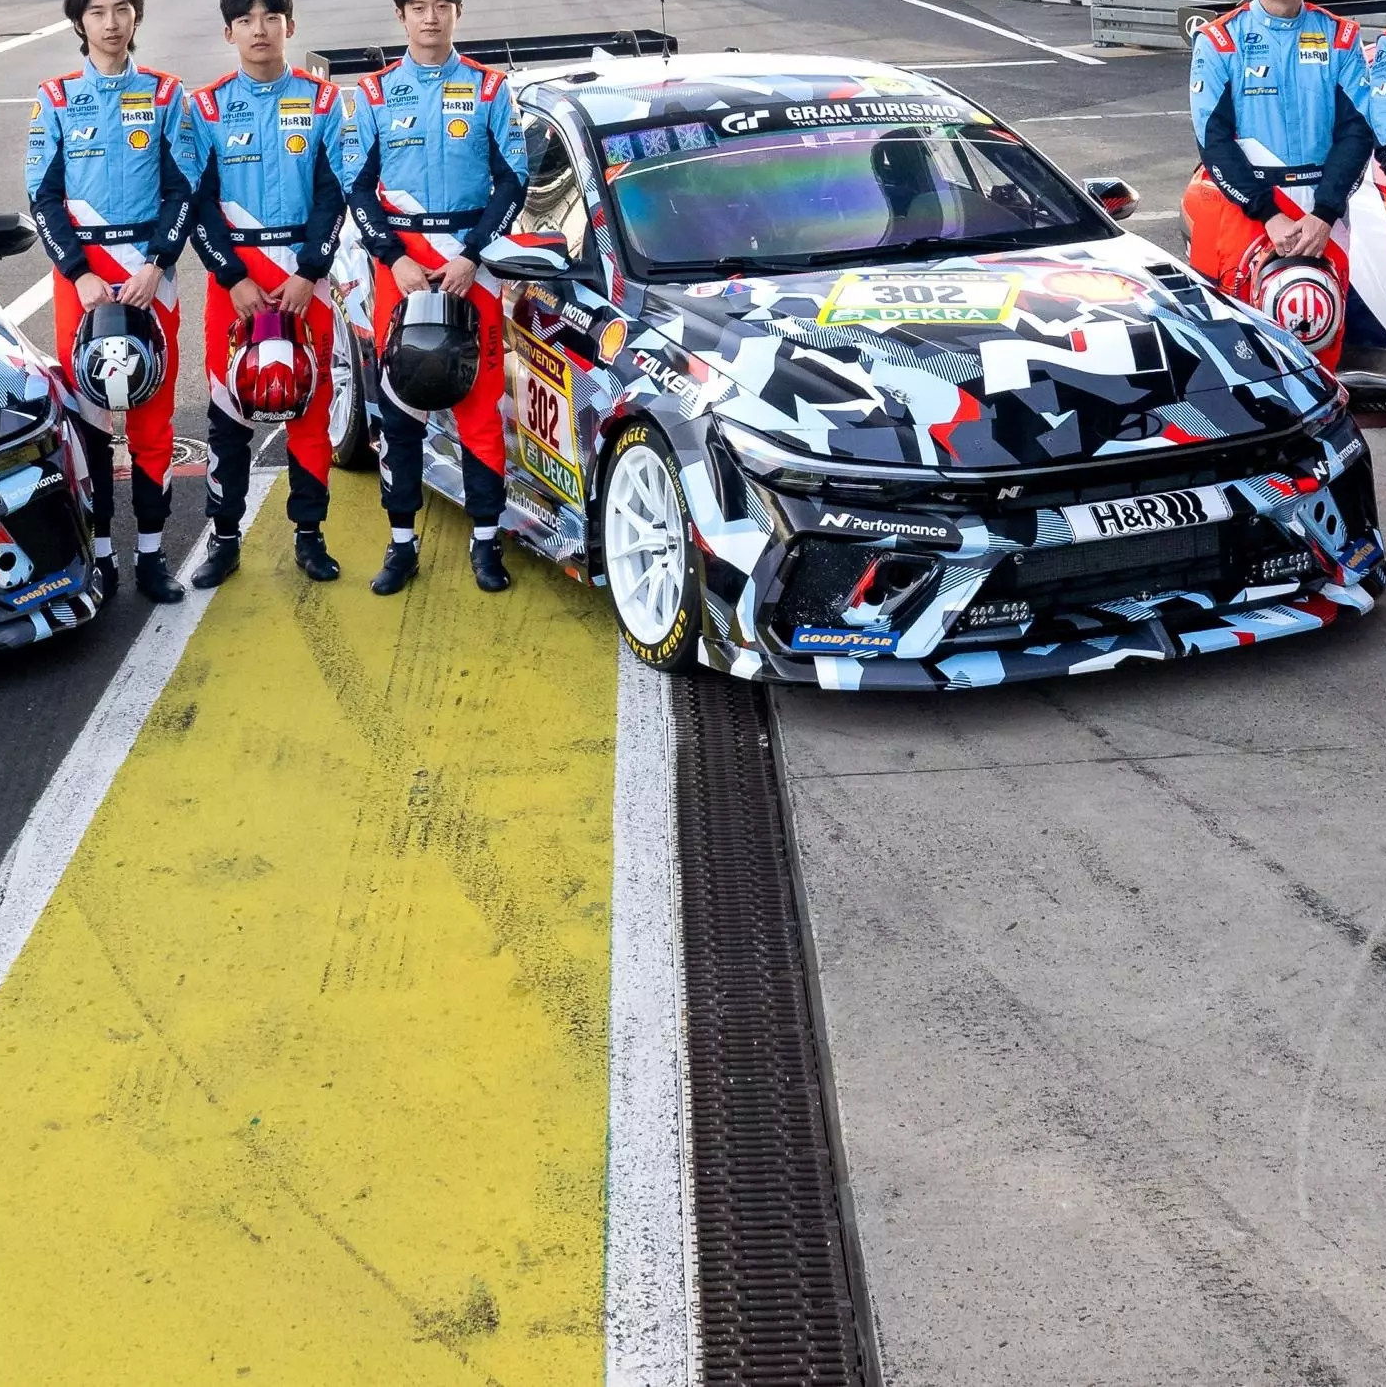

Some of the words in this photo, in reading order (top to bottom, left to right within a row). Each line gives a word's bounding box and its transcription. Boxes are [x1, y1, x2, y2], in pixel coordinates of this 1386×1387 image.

[1299, 50, 1320, 60] H&R
[441, 101, 462, 111] H&R
[785, 104, 852, 121] GRAN
[855, 102, 960, 119] TURISMO
[121, 113, 142, 122] H&R
[280, 117, 300, 126] H&R
[852, 116, 898, 124] DRIVING
[900, 115, 965, 124] SIMULATOR
[871, 284, 968, 305] 302
[562, 301, 594, 330] MOTON
[878, 307, 990, 322] DEKRA
[527, 376, 561, 450] 302
[616, 426, 650, 456] EAGLE
[541, 450, 581, 505] DEKRA
[852, 517, 948, 539] Performance
[1093, 498, 1167, 538] H&R
[13, 576, 73, 606] GOODYEAR
[797, 631, 894, 648] GOODYEAR
